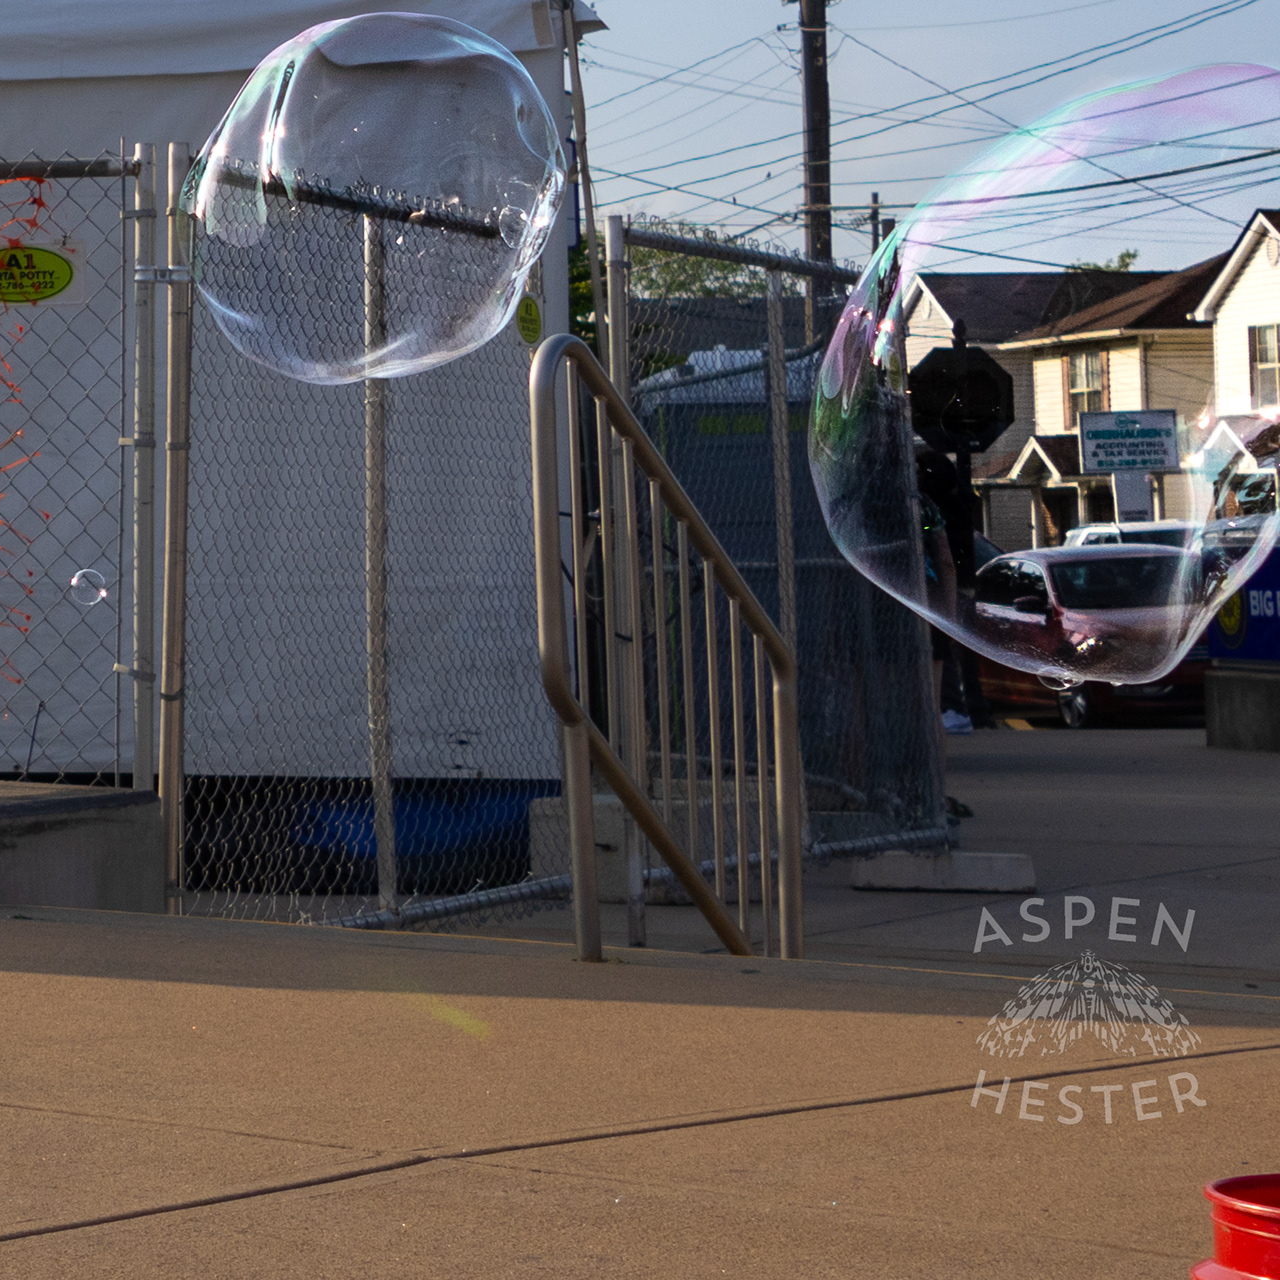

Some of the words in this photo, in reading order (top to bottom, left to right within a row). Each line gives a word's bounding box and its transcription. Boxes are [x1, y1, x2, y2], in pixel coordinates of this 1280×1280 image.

[6, 254, 36, 269] A1
[19, 270, 55, 280] POTTY
[1249, 590, 1274, 617] BIG
